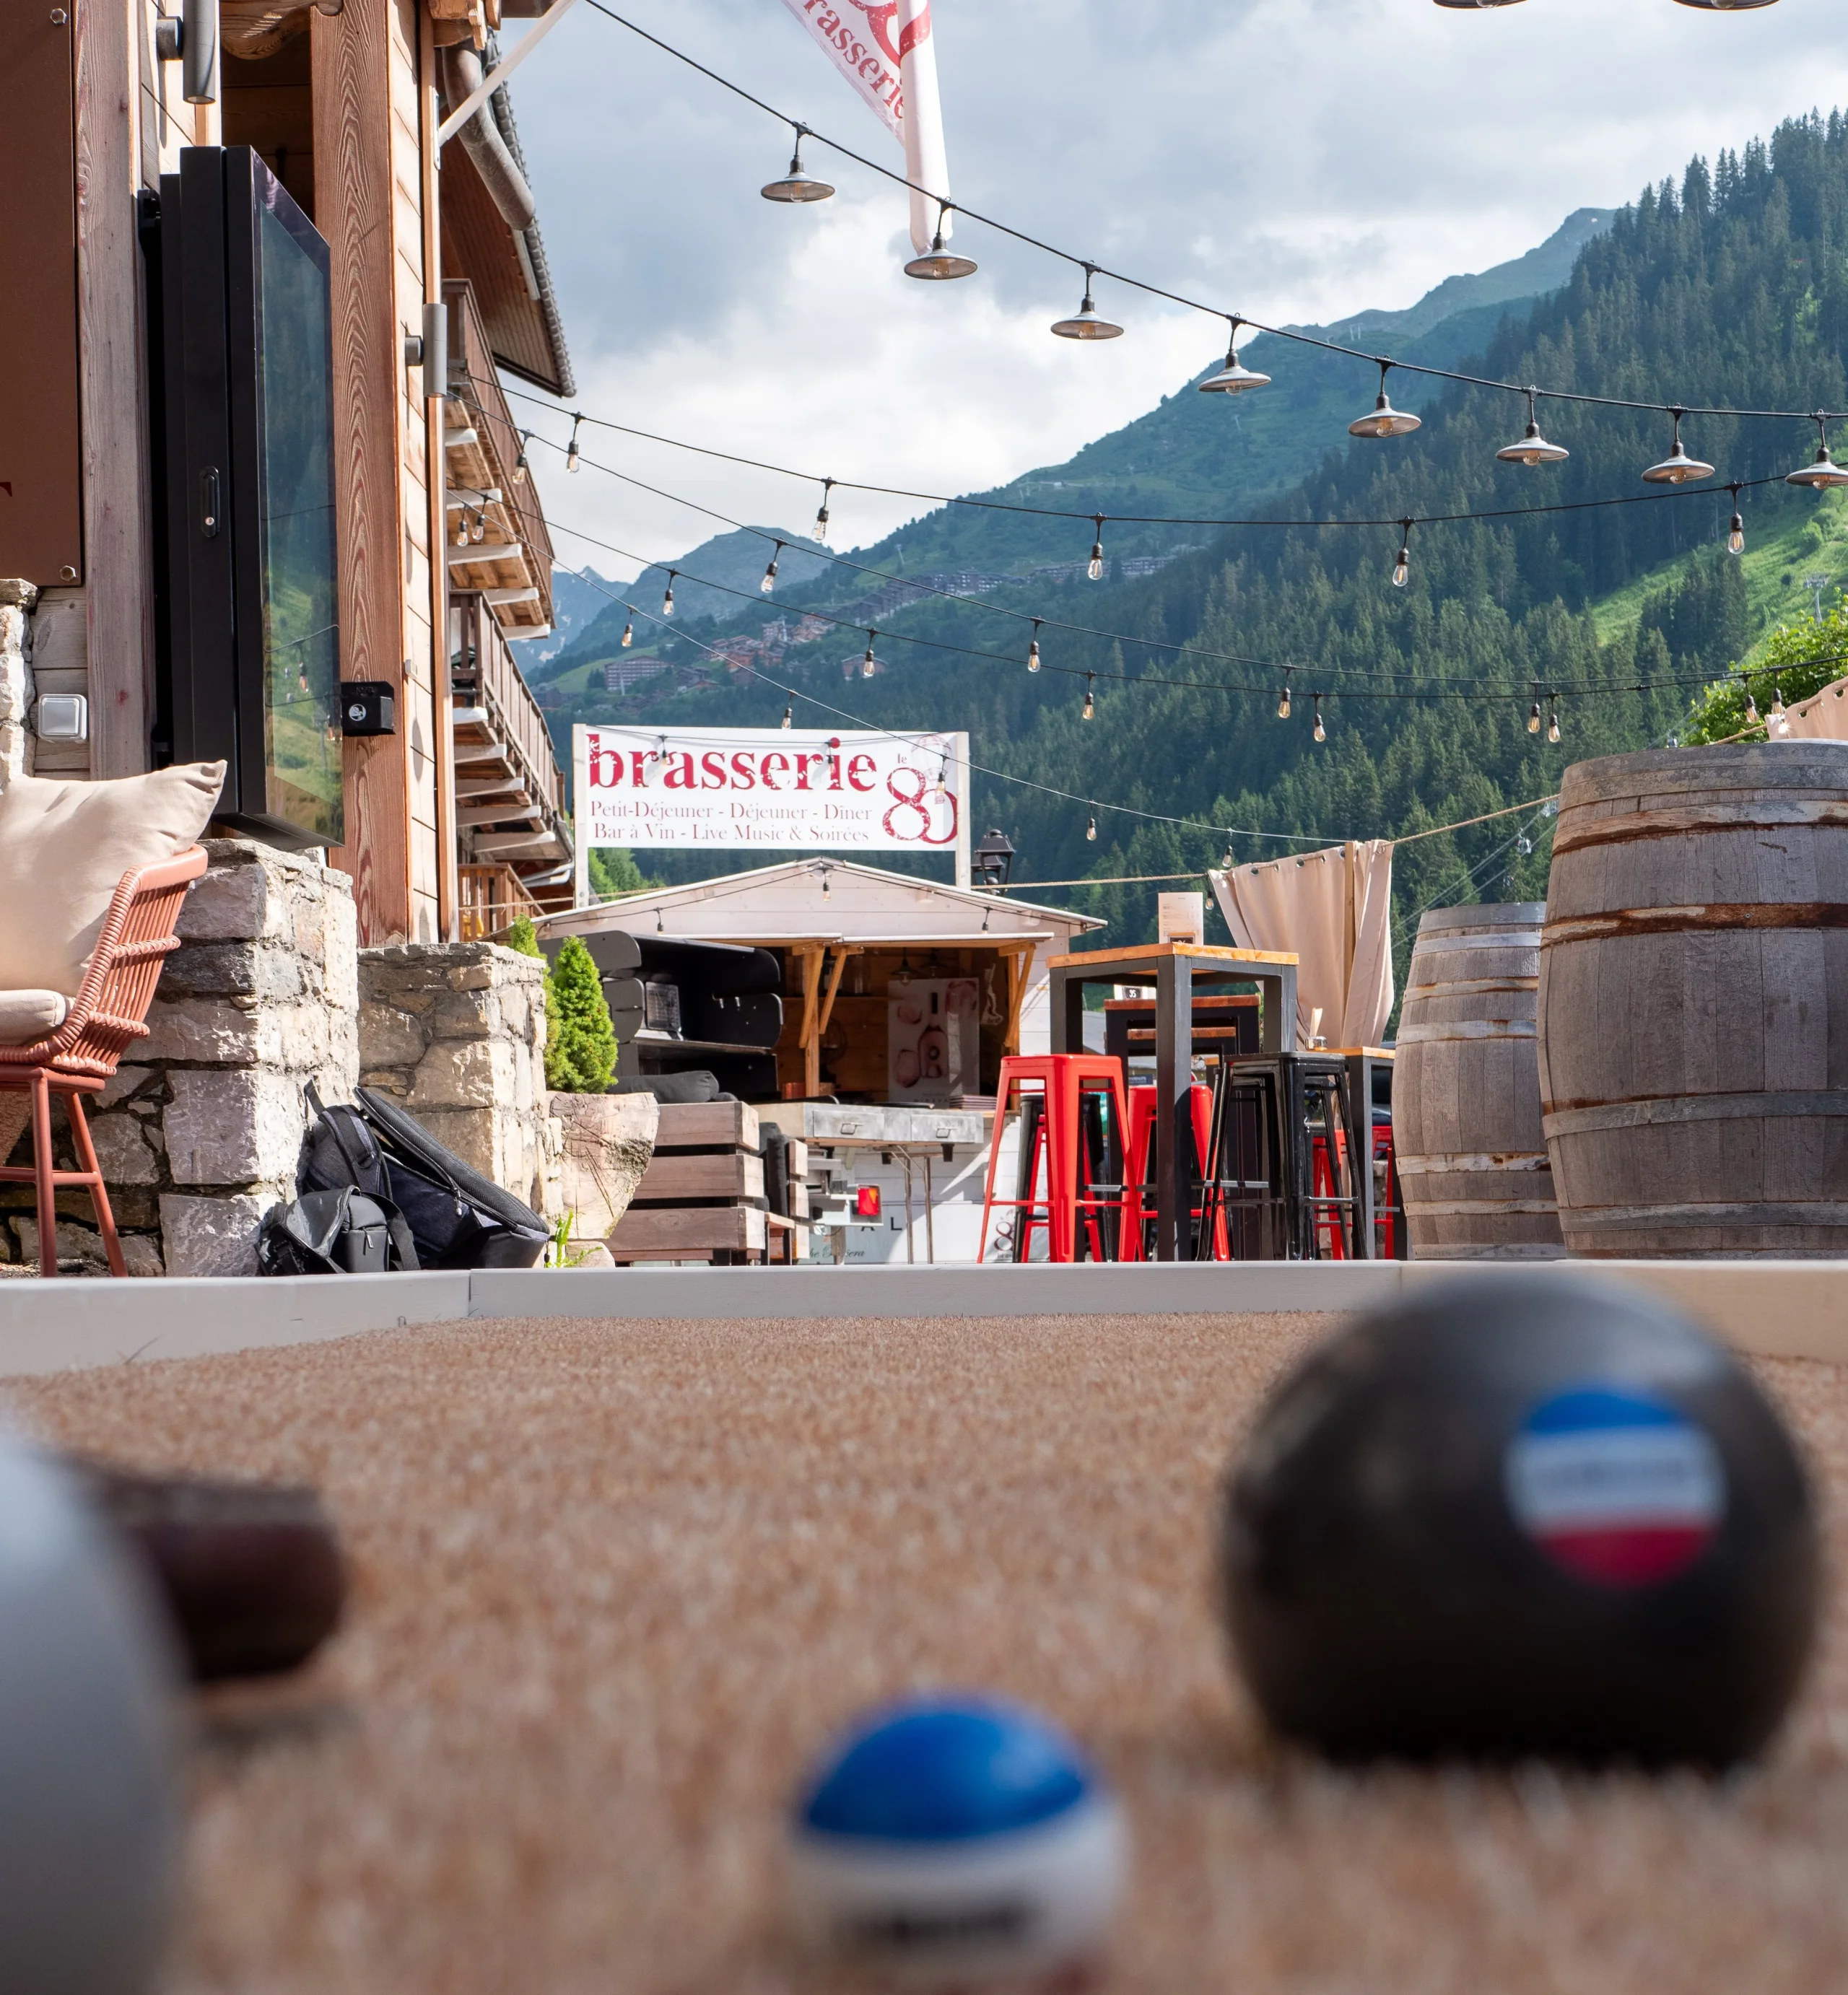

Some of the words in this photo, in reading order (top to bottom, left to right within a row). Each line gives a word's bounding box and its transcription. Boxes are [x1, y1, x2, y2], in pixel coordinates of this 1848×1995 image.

[586, 733, 877, 792] brasserie
[897, 754, 907, 764] le
[591, 800, 713, 821] Petit-Déjeuner
[730, 803, 808, 821] Déjeuner
[824, 804, 873, 820] Dîner
[595, 823, 625, 839] Bar
[630, 824, 638, 839] à
[645, 824, 674, 839] Vin
[693, 824, 727, 839] Live
[735, 824, 783, 840] Music
[790, 825, 802, 841] &
[809, 825, 869, 842] Soirées
